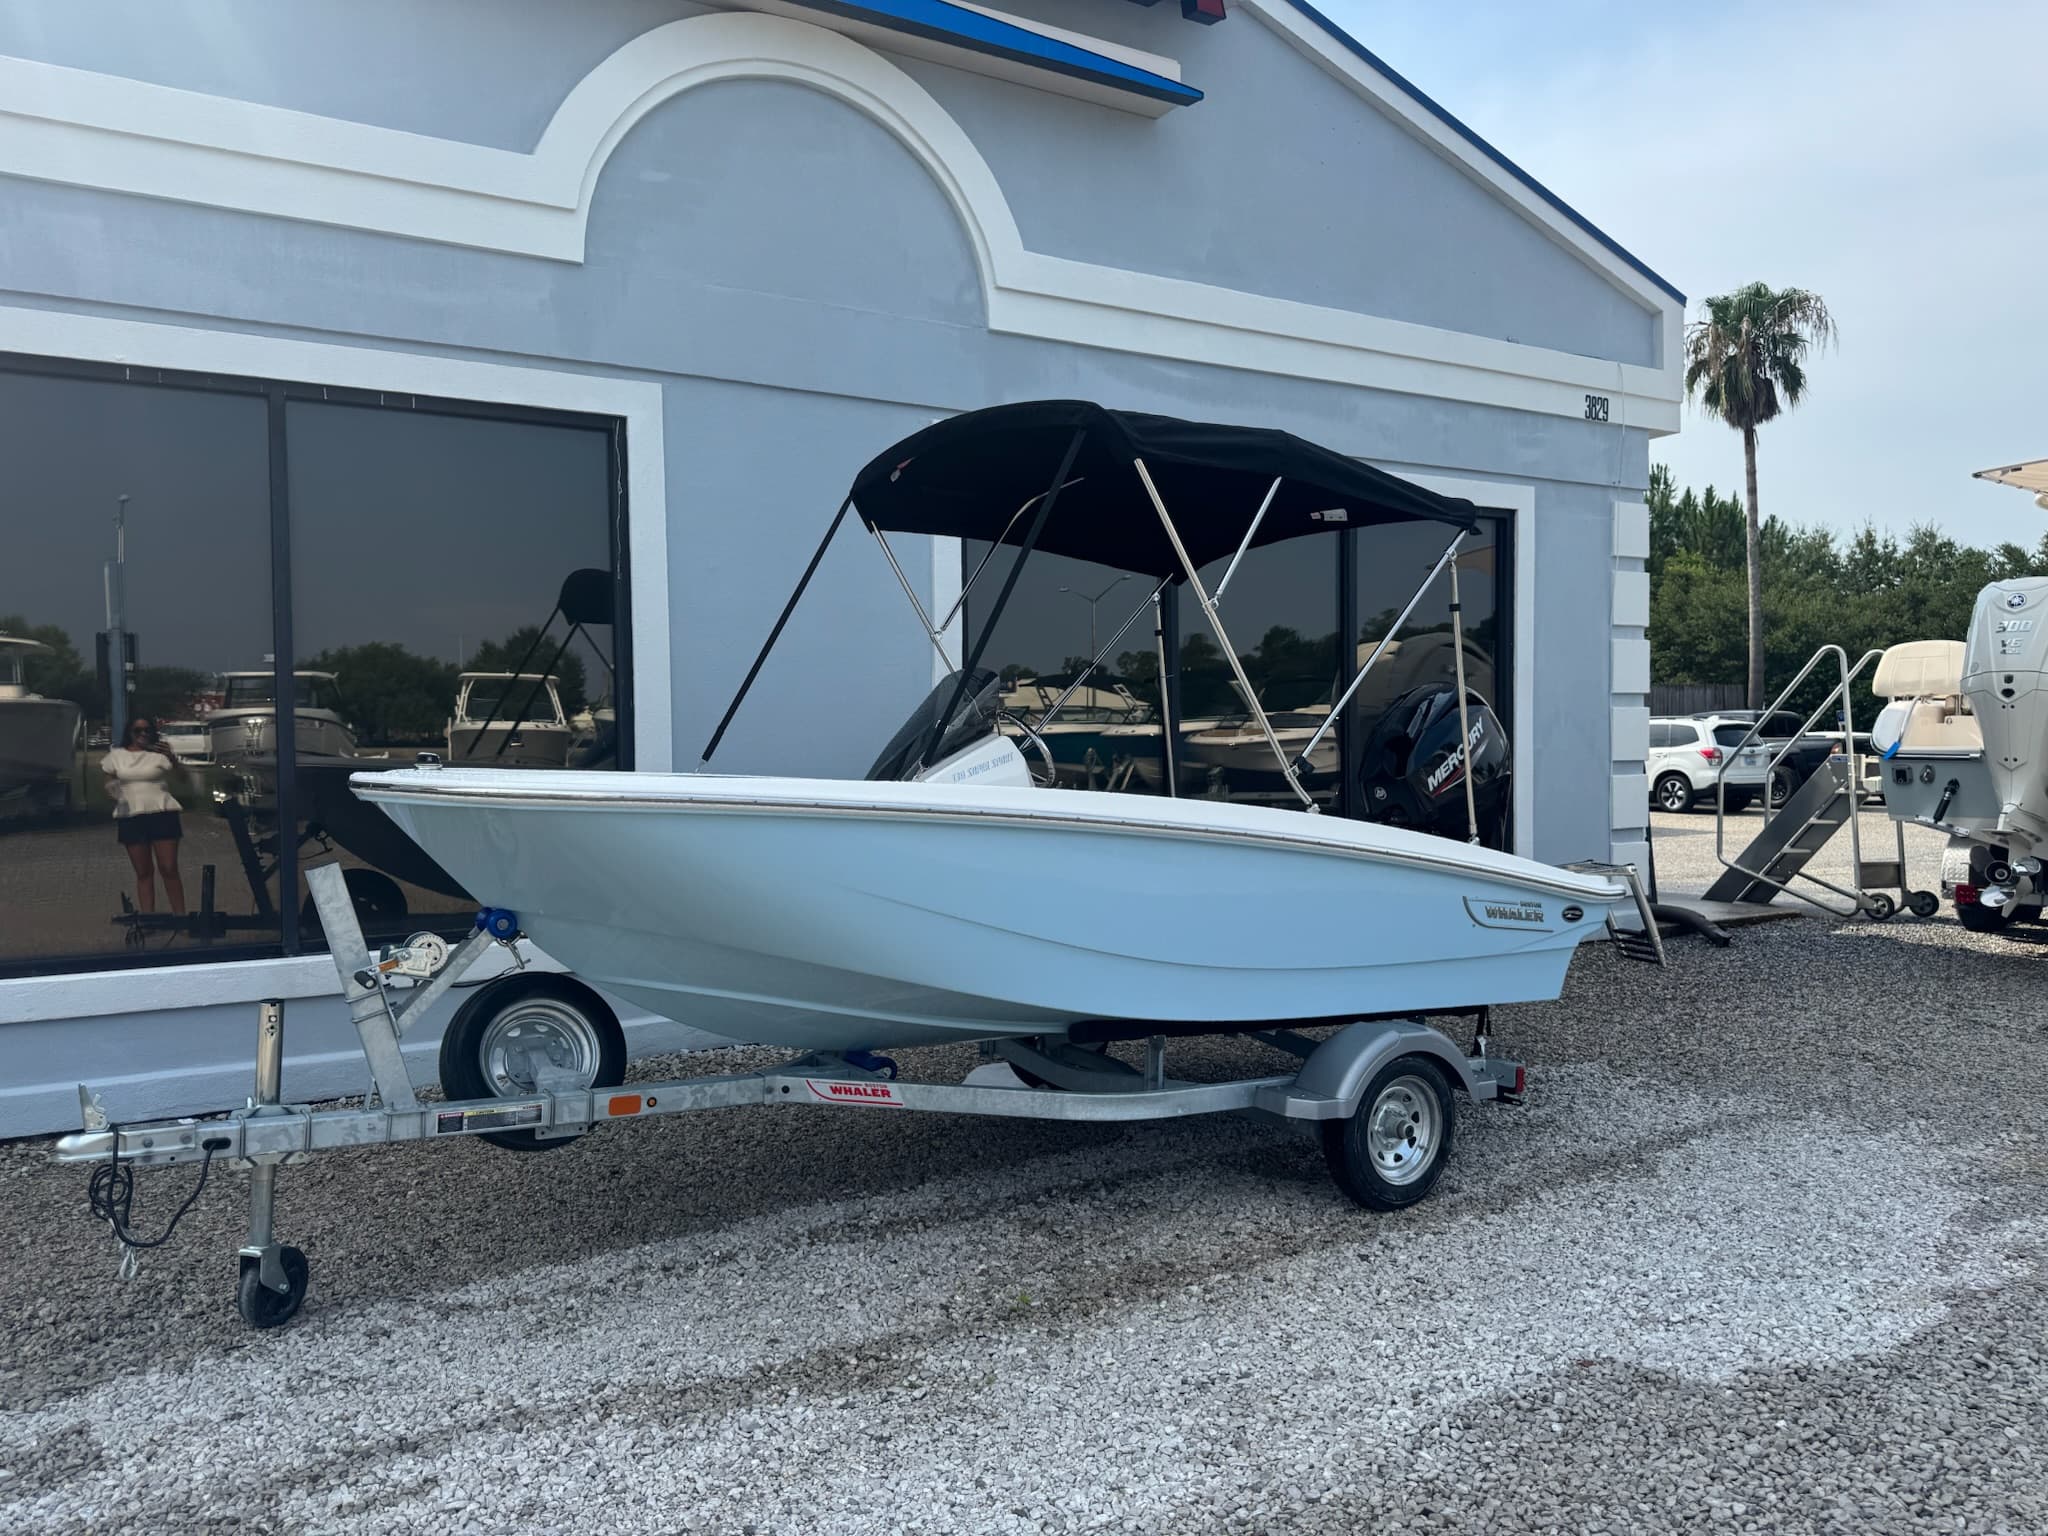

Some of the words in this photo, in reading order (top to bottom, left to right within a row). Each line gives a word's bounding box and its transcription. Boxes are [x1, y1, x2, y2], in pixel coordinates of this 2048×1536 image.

[1585, 394, 1609, 422] 3829
[1485, 905, 1545, 923] WHALER
[829, 1086, 892, 1098] WHALER
